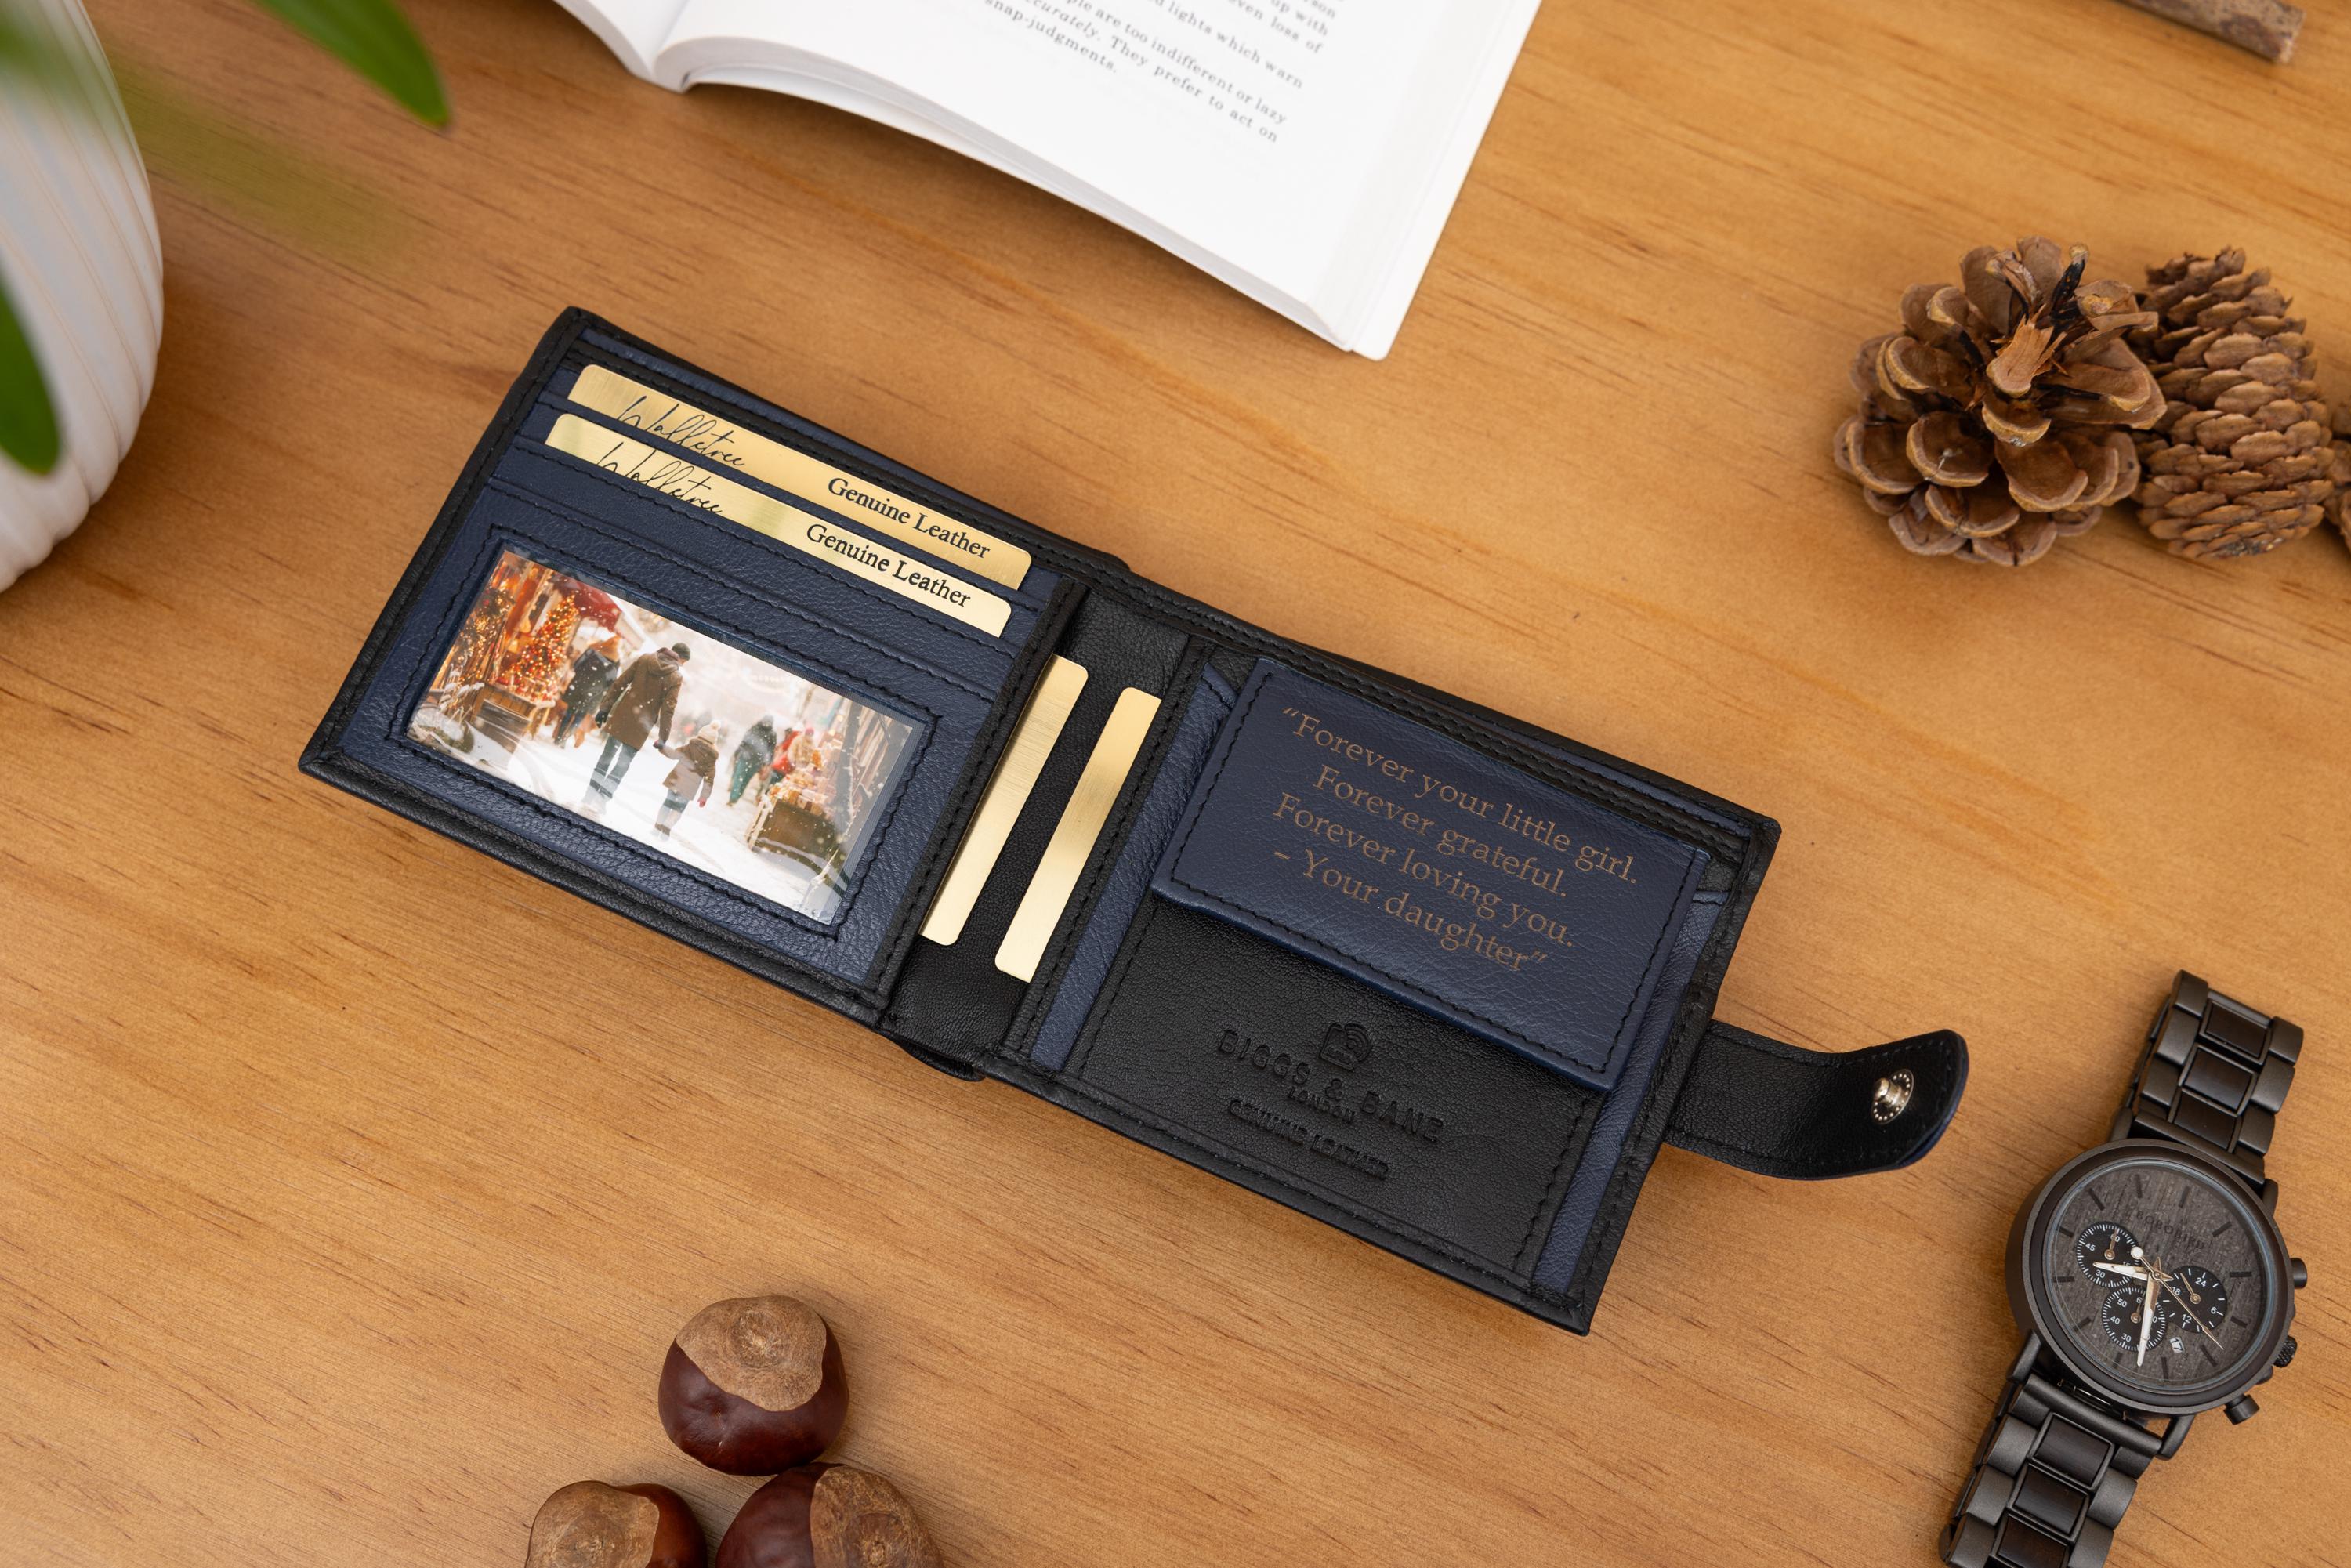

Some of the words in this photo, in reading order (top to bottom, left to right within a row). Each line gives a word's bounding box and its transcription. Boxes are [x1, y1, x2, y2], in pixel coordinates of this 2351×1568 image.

[1270, 16, 1299, 40] loss
[1306, 40, 1322, 53] of
[1295, 11, 1328, 36] with
[1168, 0, 1212, 34] lights
[1217, 31, 1260, 63] which
[1265, 60, 1302, 89] warn
[1026, 0, 1101, 40] curately.
[1110, 35, 1148, 66] They
[1154, 65, 1202, 97] prefer
[1208, 95, 1223, 110] to
[1230, 109, 1253, 128] act
[1259, 126, 1277, 143] on
[1095, 9, 1121, 28] are
[1125, 24, 1148, 43] too
[1151, 38, 1233, 92] indifferent
[1237, 91, 1253, 104] or
[1255, 98, 1286, 124] lazy
[827, 476, 910, 525] Genuine
[913, 513, 991, 559] Leather
[806, 523, 890, 573] Genuine
[892, 559, 971, 609] Leather
[1313, 765, 1435, 836] Forever
[1436, 828, 1567, 897] grateful.
[1414, 774, 1494, 819] your
[1498, 802, 1571, 852] little
[1574, 844, 1637, 884] girl.
[1272, 792, 1396, 864] Forever
[1399, 849, 1503, 920] loving
[1507, 903, 1573, 947] you.
[1303, 849, 1380, 904] Your
[1219, 1029, 1311, 1086] BIGGS
[1324, 1077, 1343, 1102] &
[2085, 1243, 2096, 1251] 45
[2095, 1269, 2106, 1278] 30
[2172, 1287, 2181, 1295] 18
[2195, 1277, 2207, 1287] 24
[2110, 1316, 2121, 1324] 40
[2117, 1298, 2127, 1308] 50
[2182, 1314, 2192, 1324] 12
[2121, 1333, 2132, 1342] 30
[2172, 1338, 2183, 1352] 17
